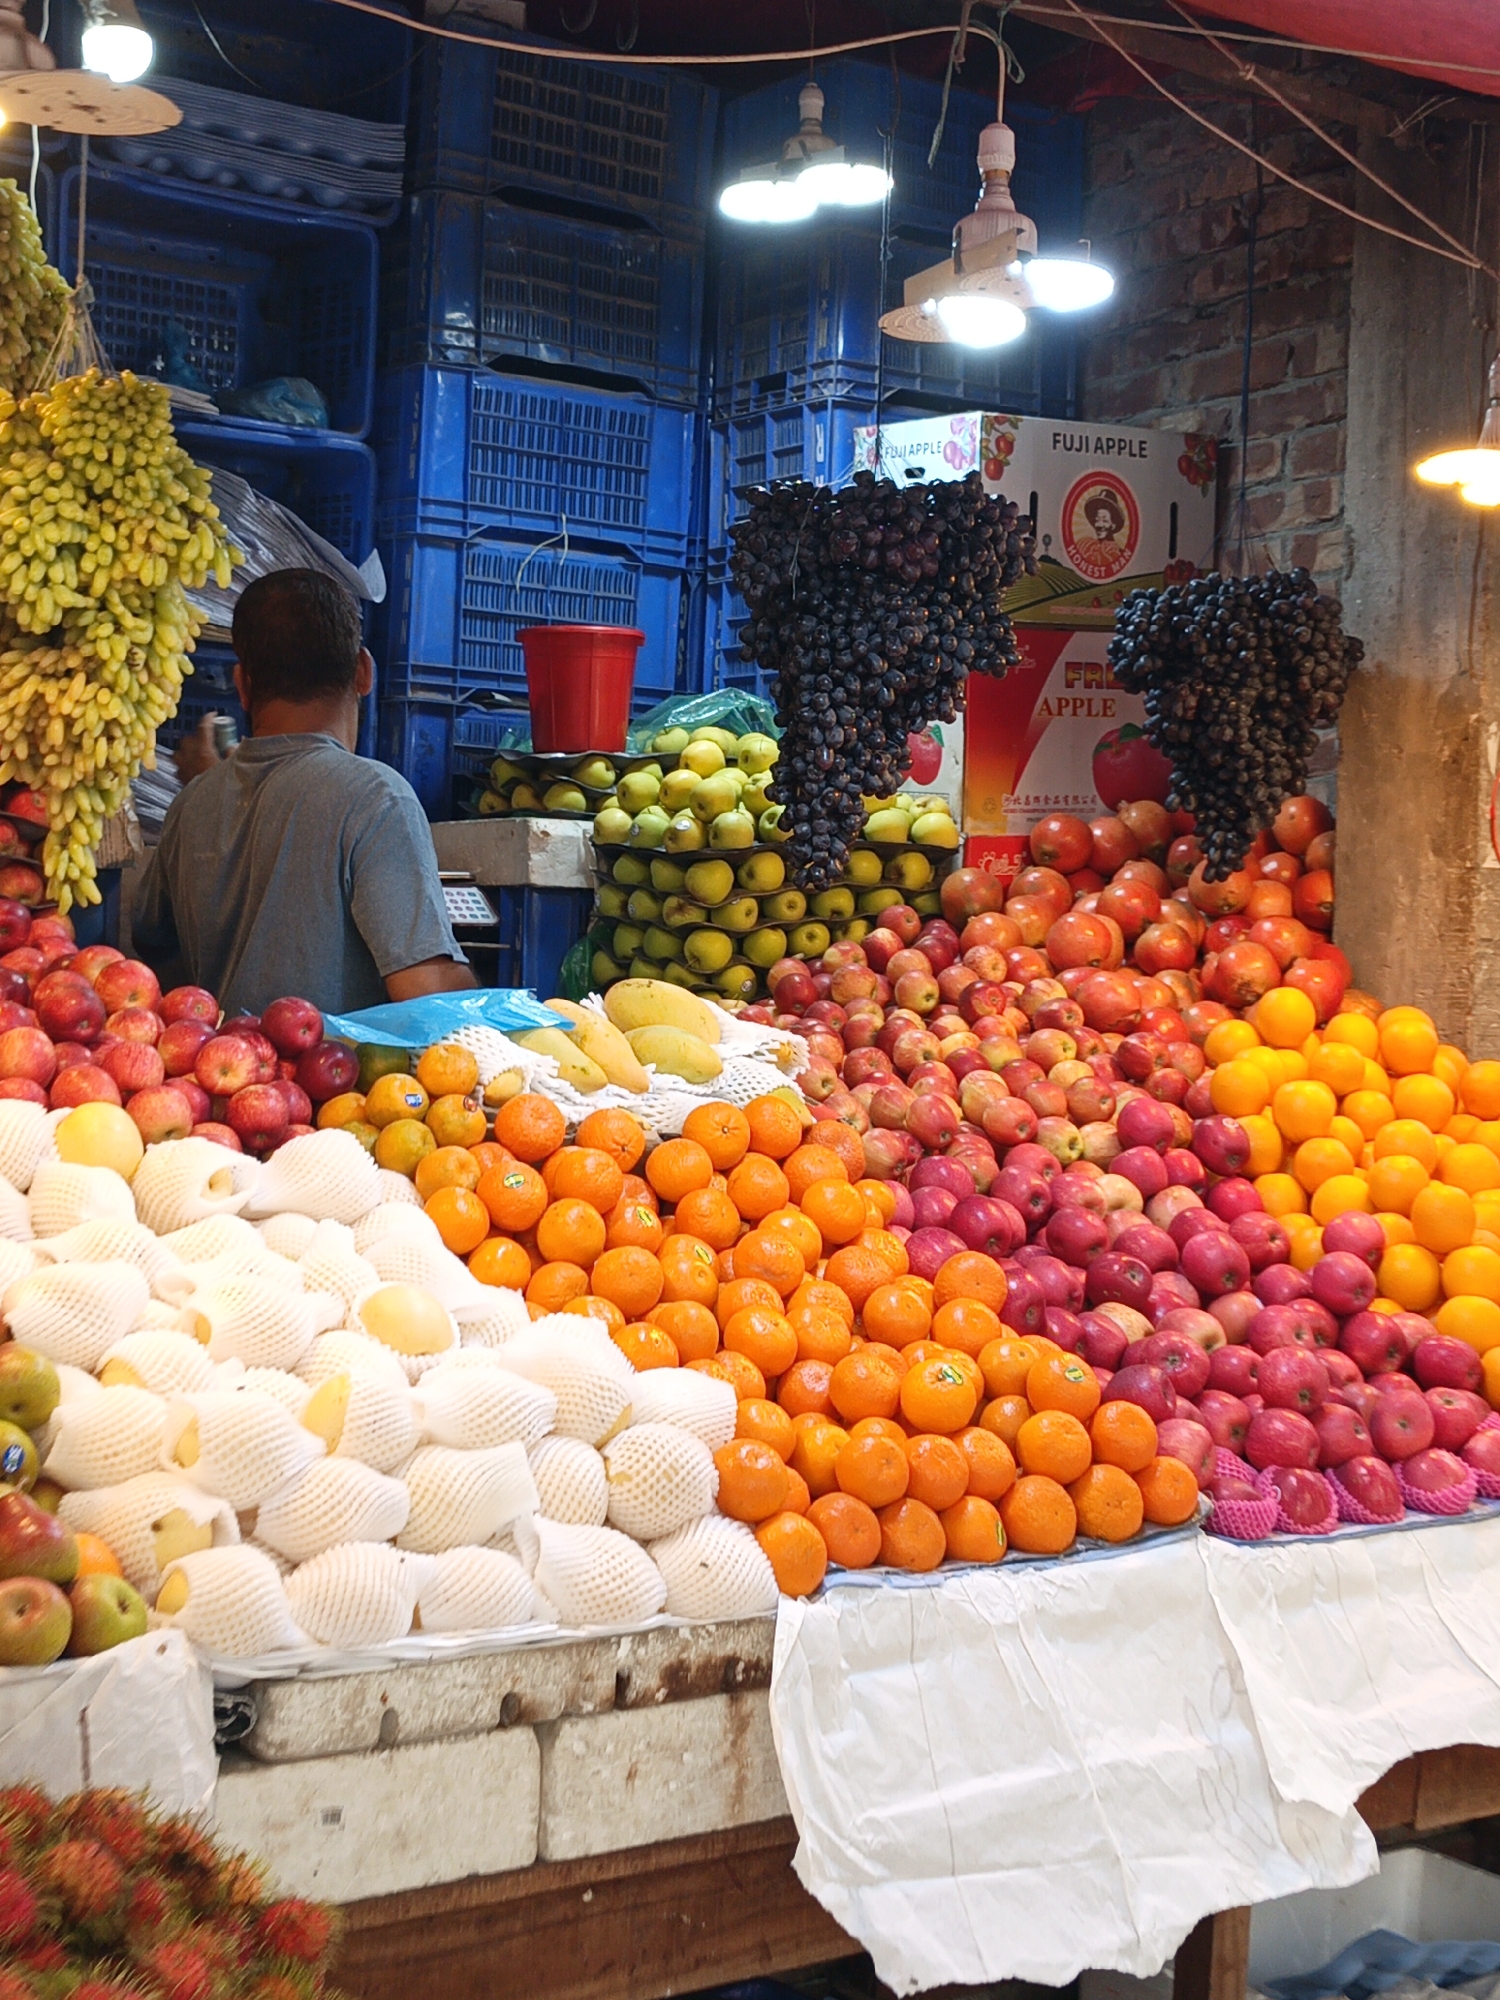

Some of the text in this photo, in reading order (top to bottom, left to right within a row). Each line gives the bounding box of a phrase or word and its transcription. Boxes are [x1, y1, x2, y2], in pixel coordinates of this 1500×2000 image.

[885, 441, 942, 459] FUJI APPLE
[1052, 432, 1148, 459] FUJI APPLE
[1067, 544, 1133, 577] HONEST MAN
[1036, 696, 1116, 718] APPLE
